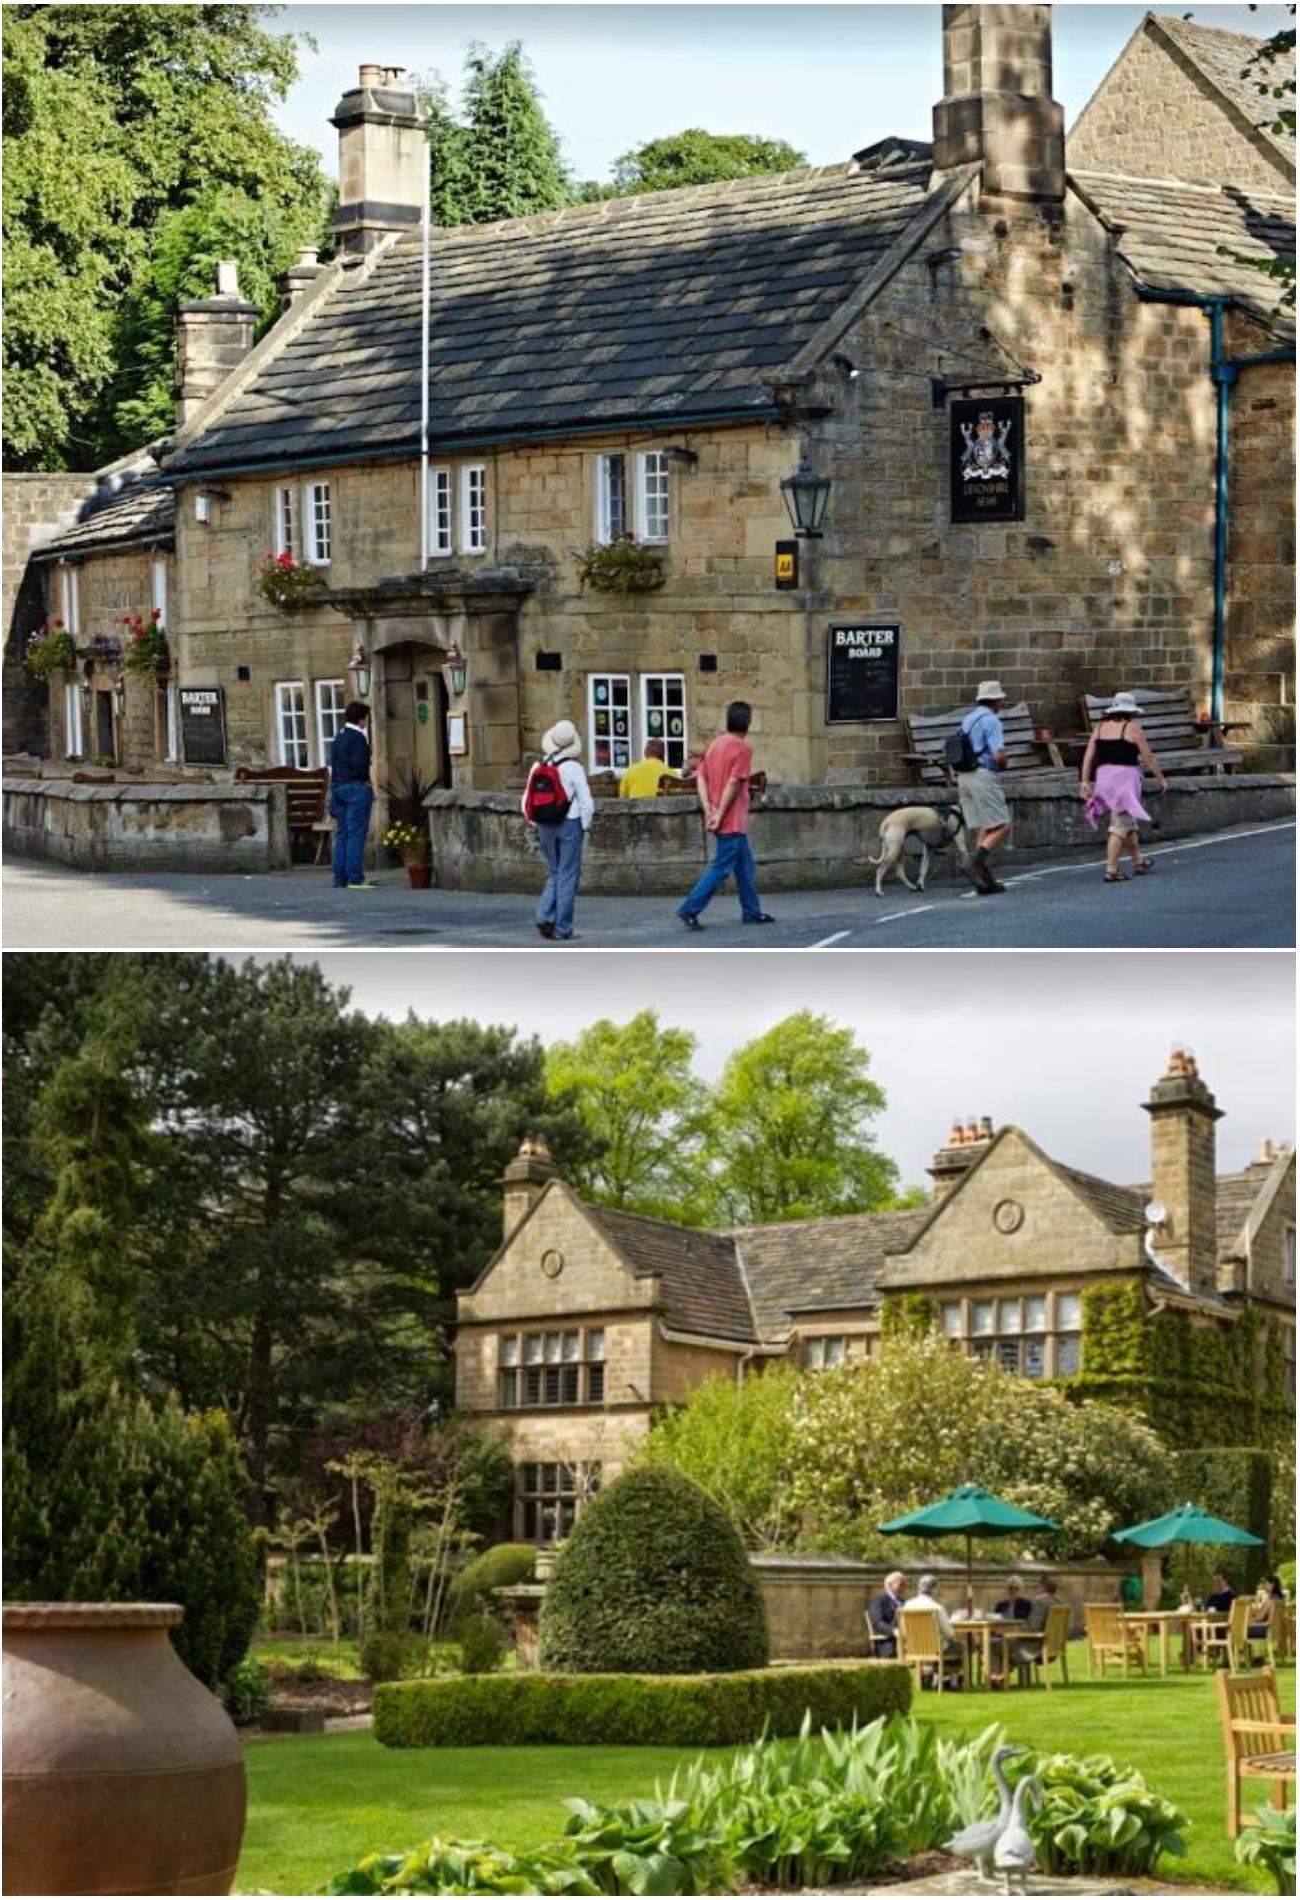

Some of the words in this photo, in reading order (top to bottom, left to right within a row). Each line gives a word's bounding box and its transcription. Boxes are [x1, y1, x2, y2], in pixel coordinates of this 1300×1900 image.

[835, 630, 894, 646] BARTER
[848, 647, 883, 659] BOARD
[182, 691, 218, 705] BARTER
